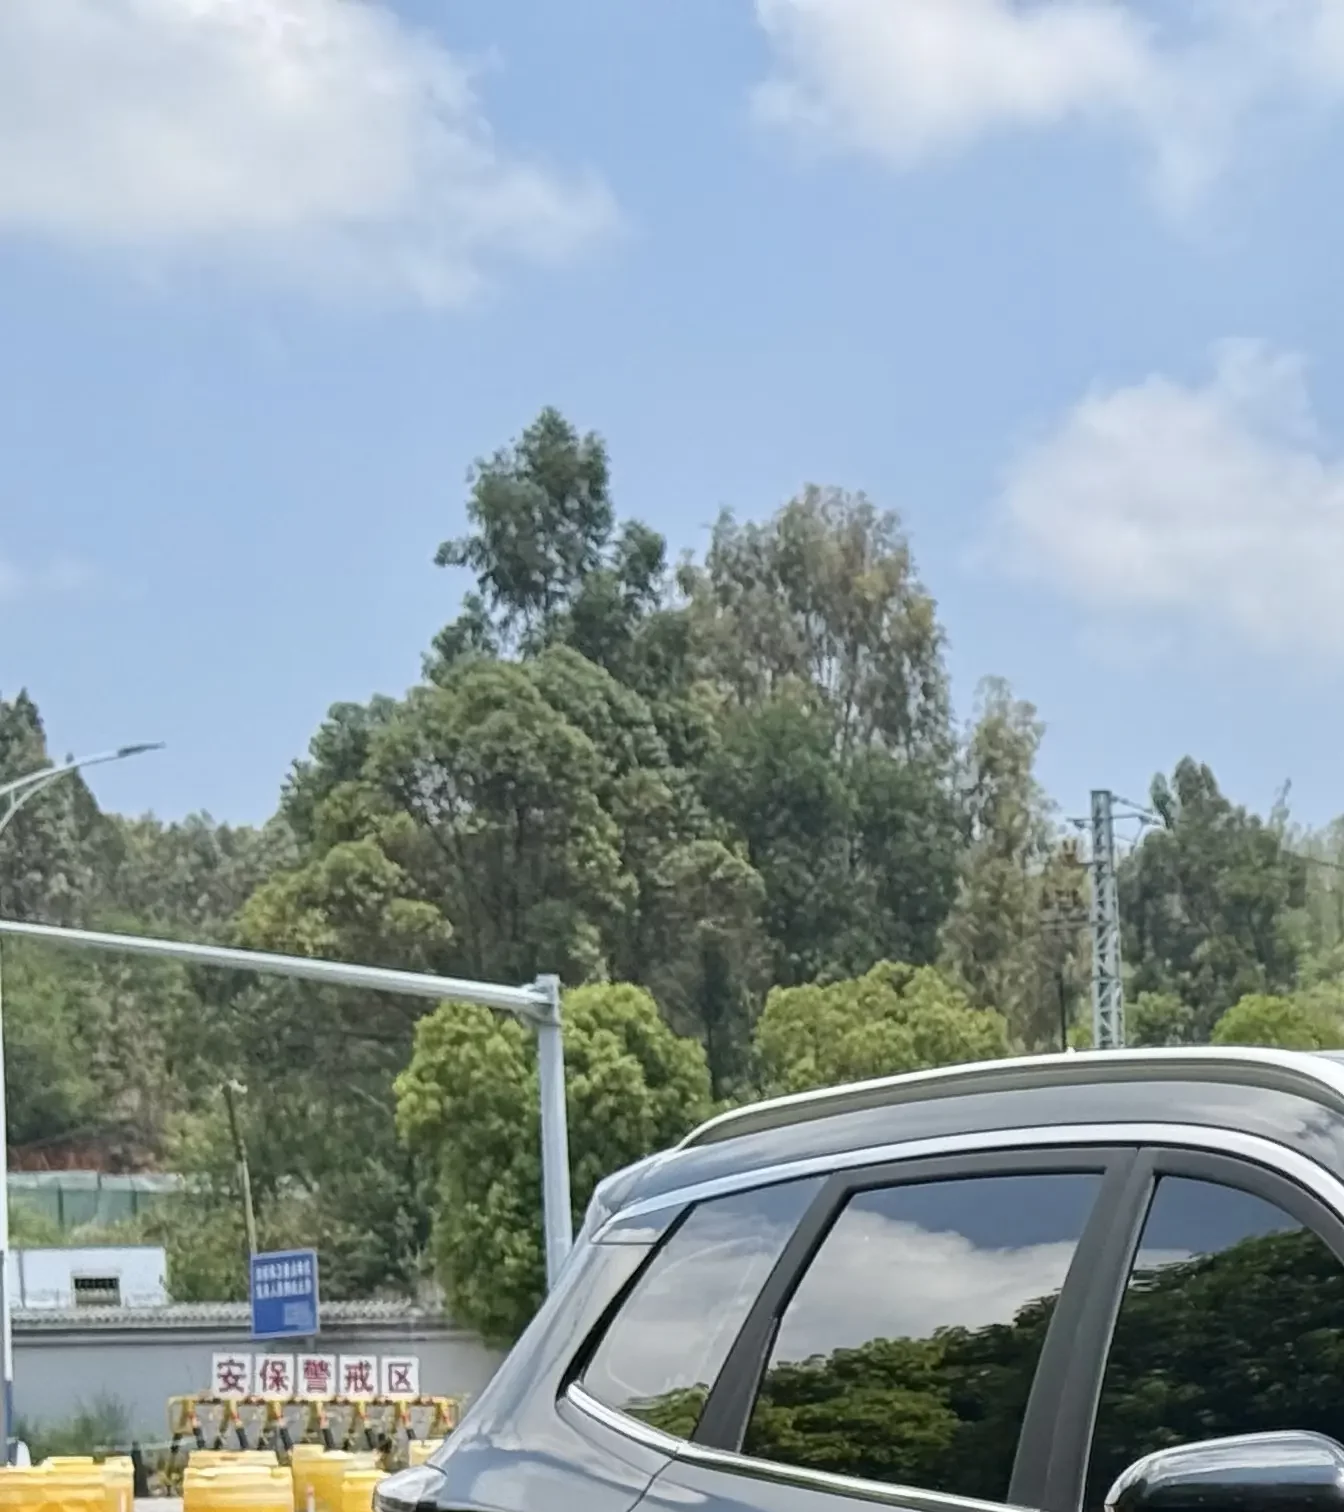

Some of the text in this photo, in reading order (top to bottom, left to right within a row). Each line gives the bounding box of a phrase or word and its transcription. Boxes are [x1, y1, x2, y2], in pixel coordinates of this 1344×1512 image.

[217, 1359, 415, 1393] 安保警戒区
